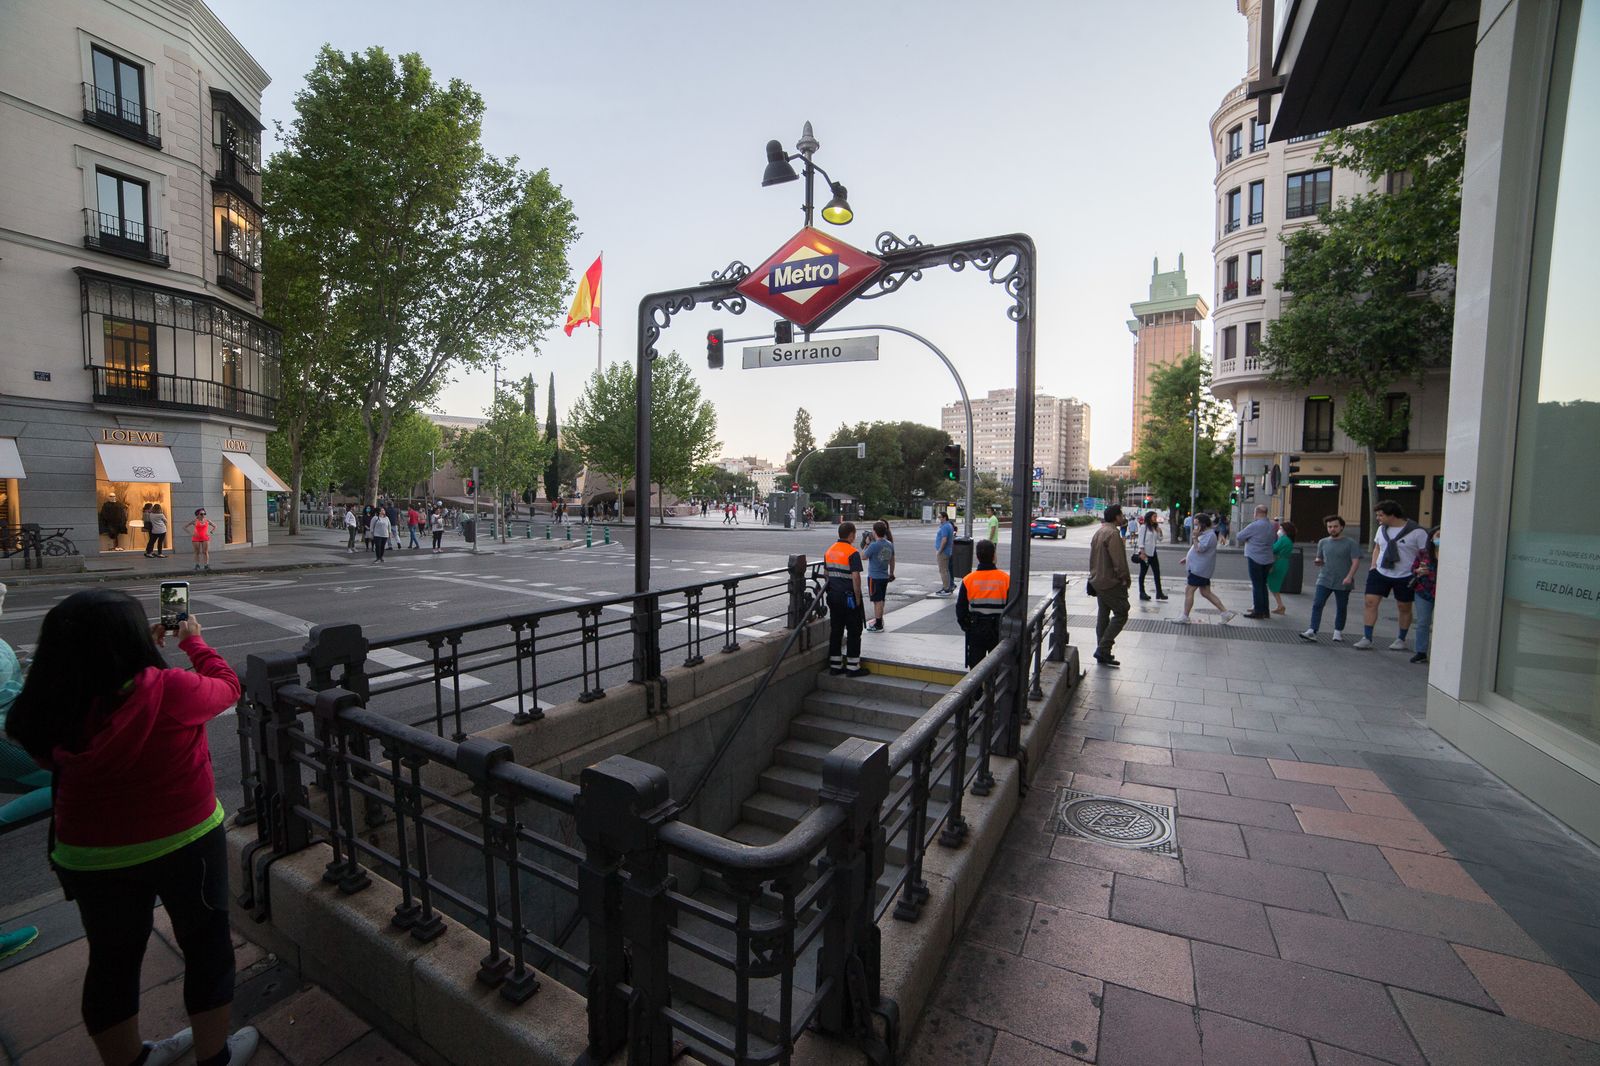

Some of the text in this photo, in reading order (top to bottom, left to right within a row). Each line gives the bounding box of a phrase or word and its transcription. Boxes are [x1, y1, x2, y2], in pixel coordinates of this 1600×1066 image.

[774, 263, 834, 287] Metro
[772, 346, 842, 362] Serrano
[103, 429, 164, 443] LOEWE
[224, 439, 250, 451] LOEWE
[1536, 580, 1557, 593] FELIZ
[1559, 584, 1573, 597] DÍA
[1576, 588, 1593, 600] DEL
